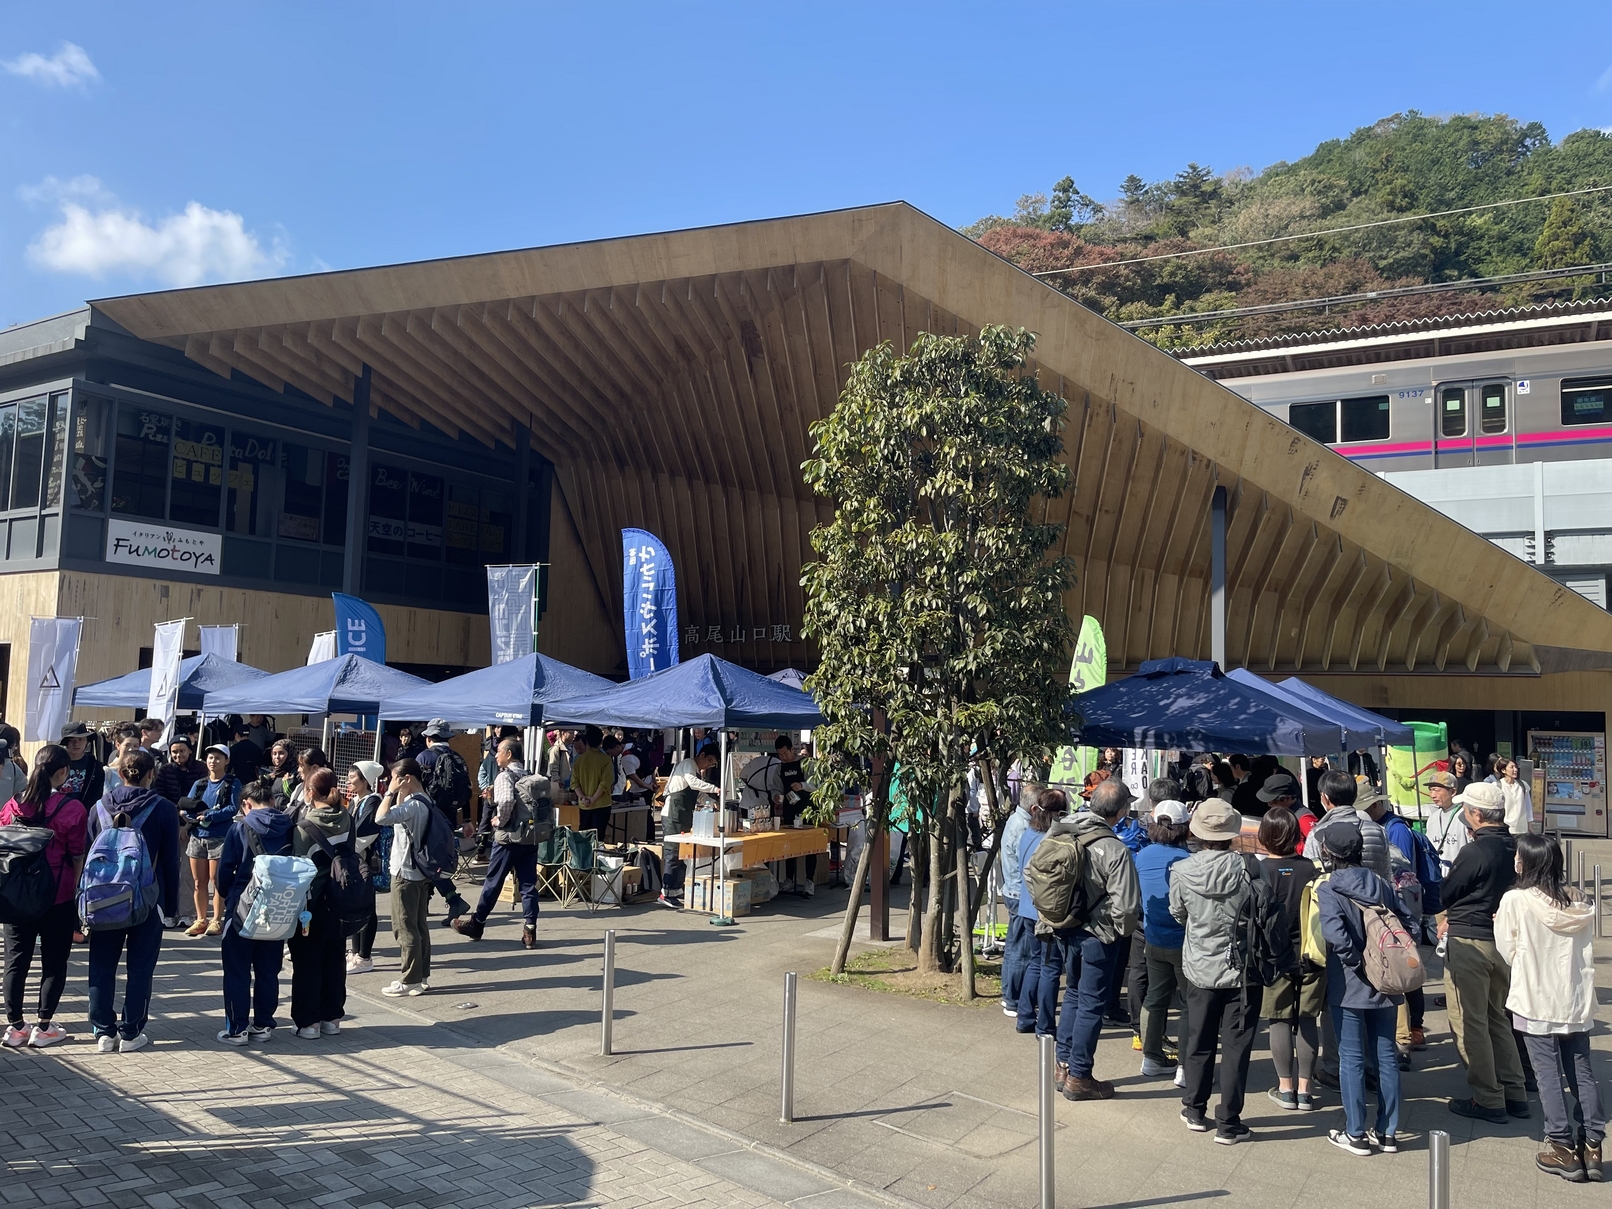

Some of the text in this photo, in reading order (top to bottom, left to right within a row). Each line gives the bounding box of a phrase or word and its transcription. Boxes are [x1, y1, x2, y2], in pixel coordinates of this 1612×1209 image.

[1398, 390, 1425, 399] 9137
[139, 423, 170, 444] Pizz
[174, 441, 222, 462] CAFE
[245, 438, 288, 461] Dole
[174, 462, 253, 488] ビュッフェ
[375, 468, 405, 490] Bee
[410, 477, 442, 499] Wine
[133, 530, 205, 546] イタリアン ふもとや
[369, 521, 443, 541] 天空のコーヒー
[684, 624, 793, 645] 高尾山口駅
[272, 880, 297, 923] NORTH
[283, 900, 300, 923] THE
